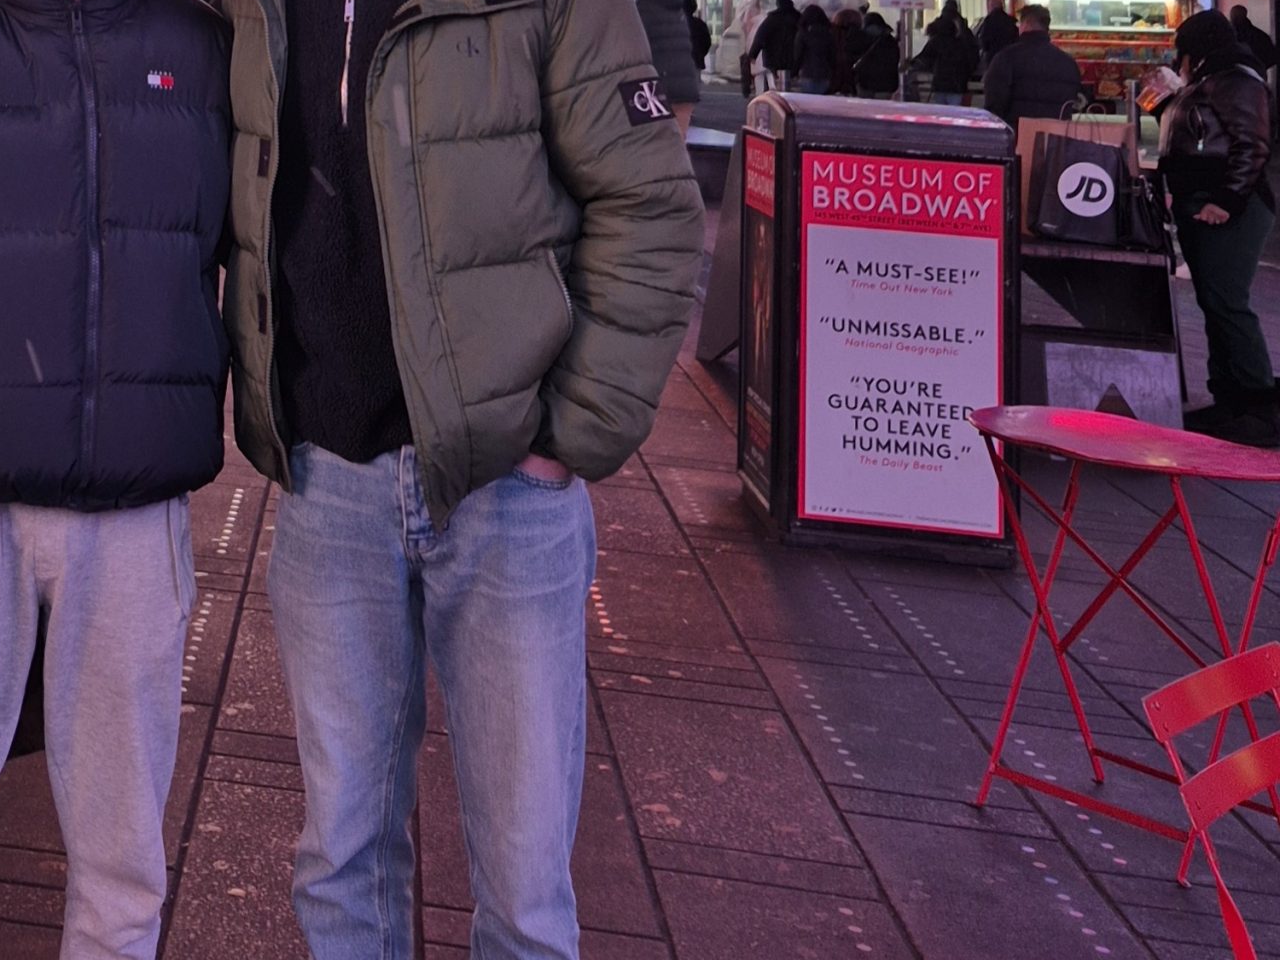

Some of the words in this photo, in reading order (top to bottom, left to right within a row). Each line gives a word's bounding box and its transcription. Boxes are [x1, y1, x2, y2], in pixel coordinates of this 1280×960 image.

[812, 160, 943, 192] MUSEUM
[952, 170, 994, 195] OF
[1065, 175, 1108, 203] JD
[812, 185, 993, 222] BROADWAY
[850, 279, 877, 290] Time
[879, 281, 900, 293] Out
[903, 284, 929, 295] New
[931, 286, 954, 297] York
[844, 337, 893, 351] National
[895, 340, 960, 357] Geographic
[827, 393, 975, 422] GUARANTEED
[851, 415, 879, 432] TO
[886, 418, 952, 440] LEAVE
[858, 455, 878, 466] The
[881, 457, 909, 470] Daily
[912, 461, 943, 472] Beast
